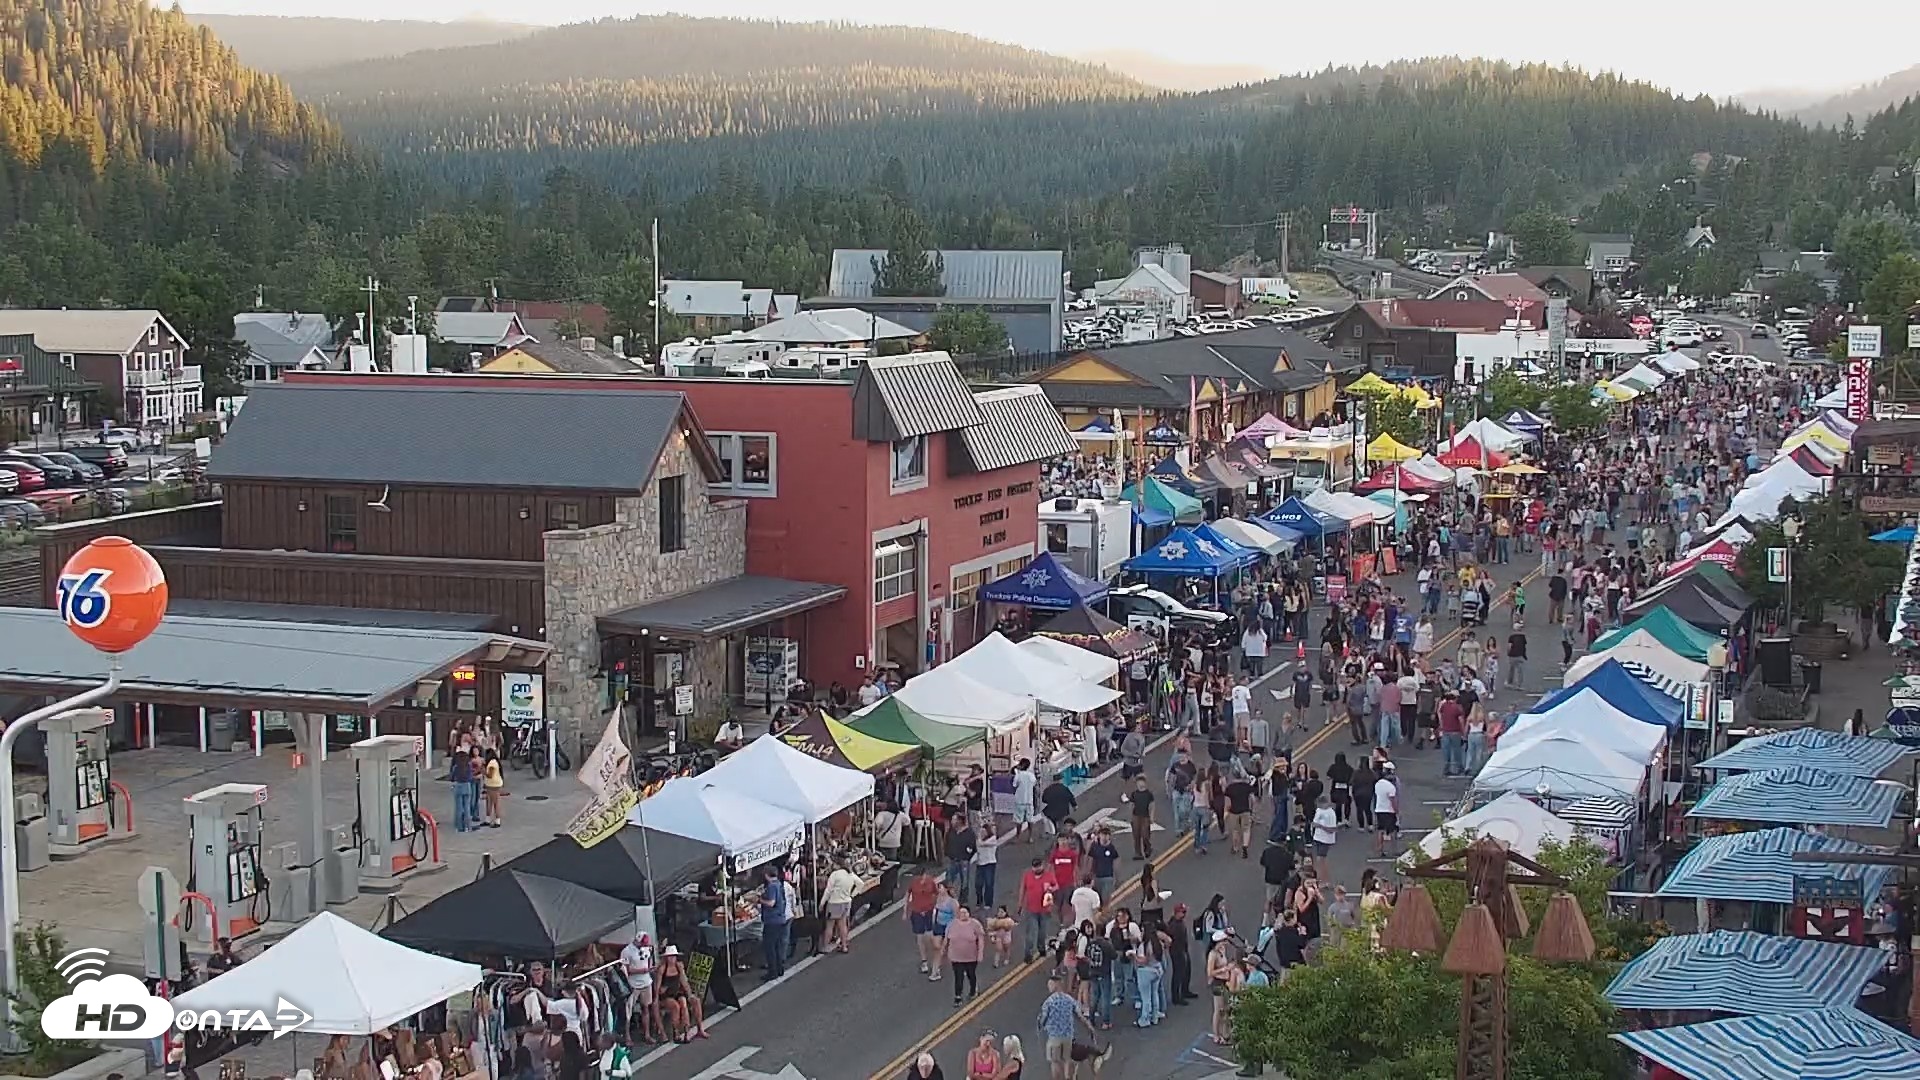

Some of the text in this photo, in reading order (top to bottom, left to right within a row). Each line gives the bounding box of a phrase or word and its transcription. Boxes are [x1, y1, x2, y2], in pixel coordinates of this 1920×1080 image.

[1848, 361, 1861, 418] CAFE
[57, 568, 113, 628] 76
[1012, 593, 1032, 602] Police
[512, 683, 532, 695] pm
